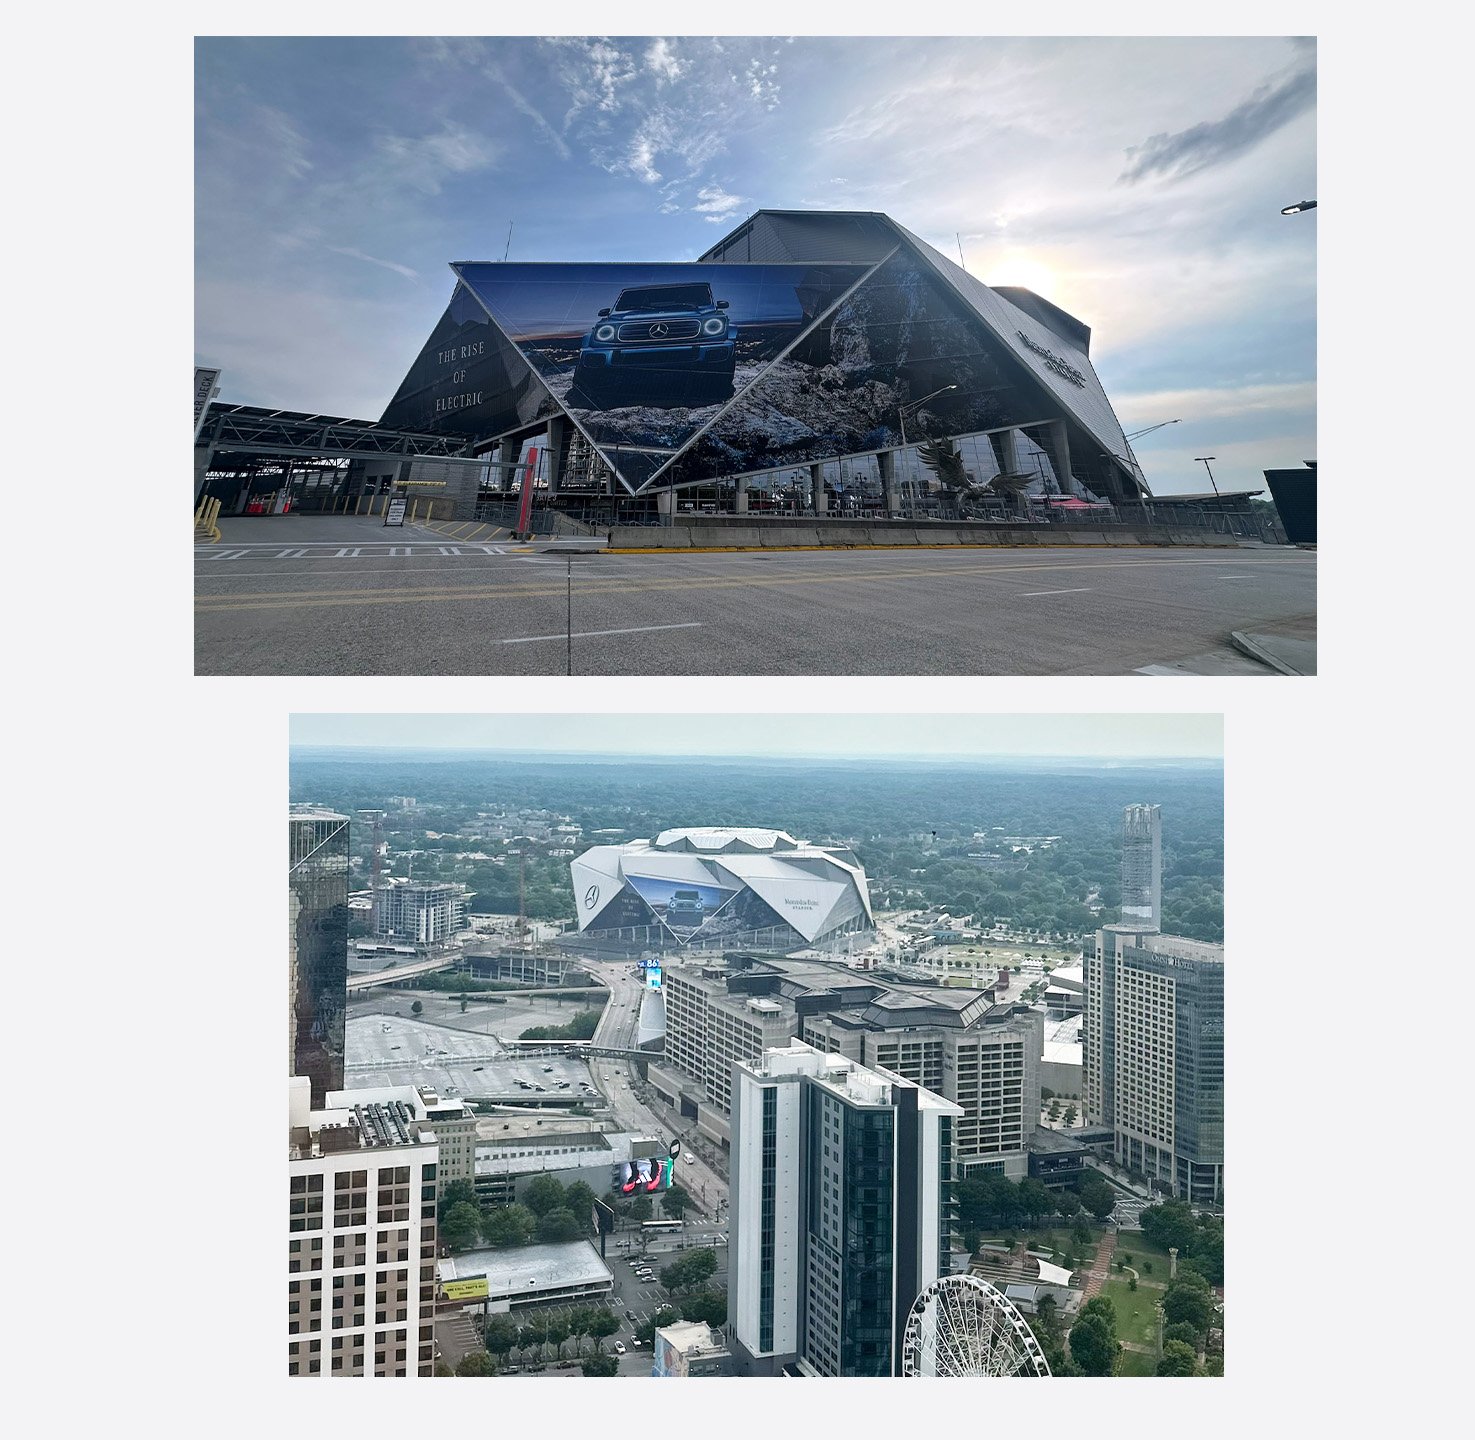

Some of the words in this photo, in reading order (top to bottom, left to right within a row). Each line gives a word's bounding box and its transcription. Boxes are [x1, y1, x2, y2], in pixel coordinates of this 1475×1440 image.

[438, 348, 457, 364] THE
[461, 341, 485, 359] RISE
[197, 376, 214, 398] DECK
[453, 369, 467, 384] OF
[436, 391, 483, 411] ELECTRIC
